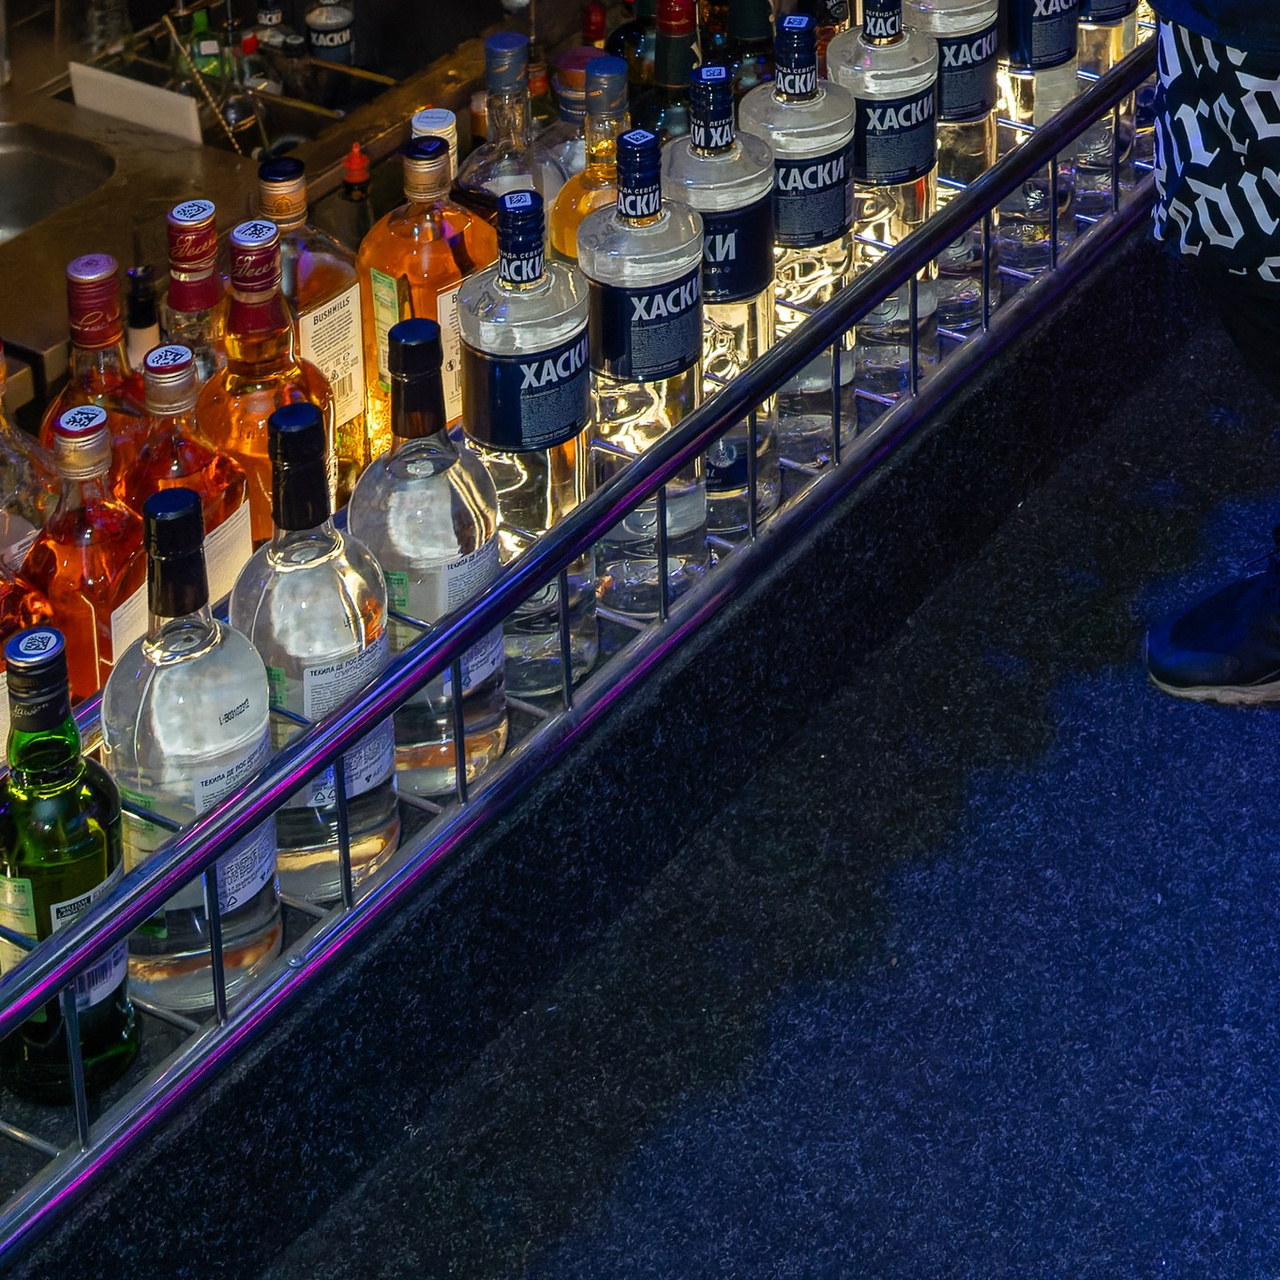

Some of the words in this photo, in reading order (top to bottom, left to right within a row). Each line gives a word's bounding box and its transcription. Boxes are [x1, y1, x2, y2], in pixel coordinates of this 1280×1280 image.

[866, 92, 933, 131] ХАСКИ
[313, 296, 351, 326] BUSHMILLS
[310, 666, 335, 677] ТЕКИЛА
[201, 773, 226, 788] ТЕКИЛА
[60, 898, 88, 913] WILLIAM
